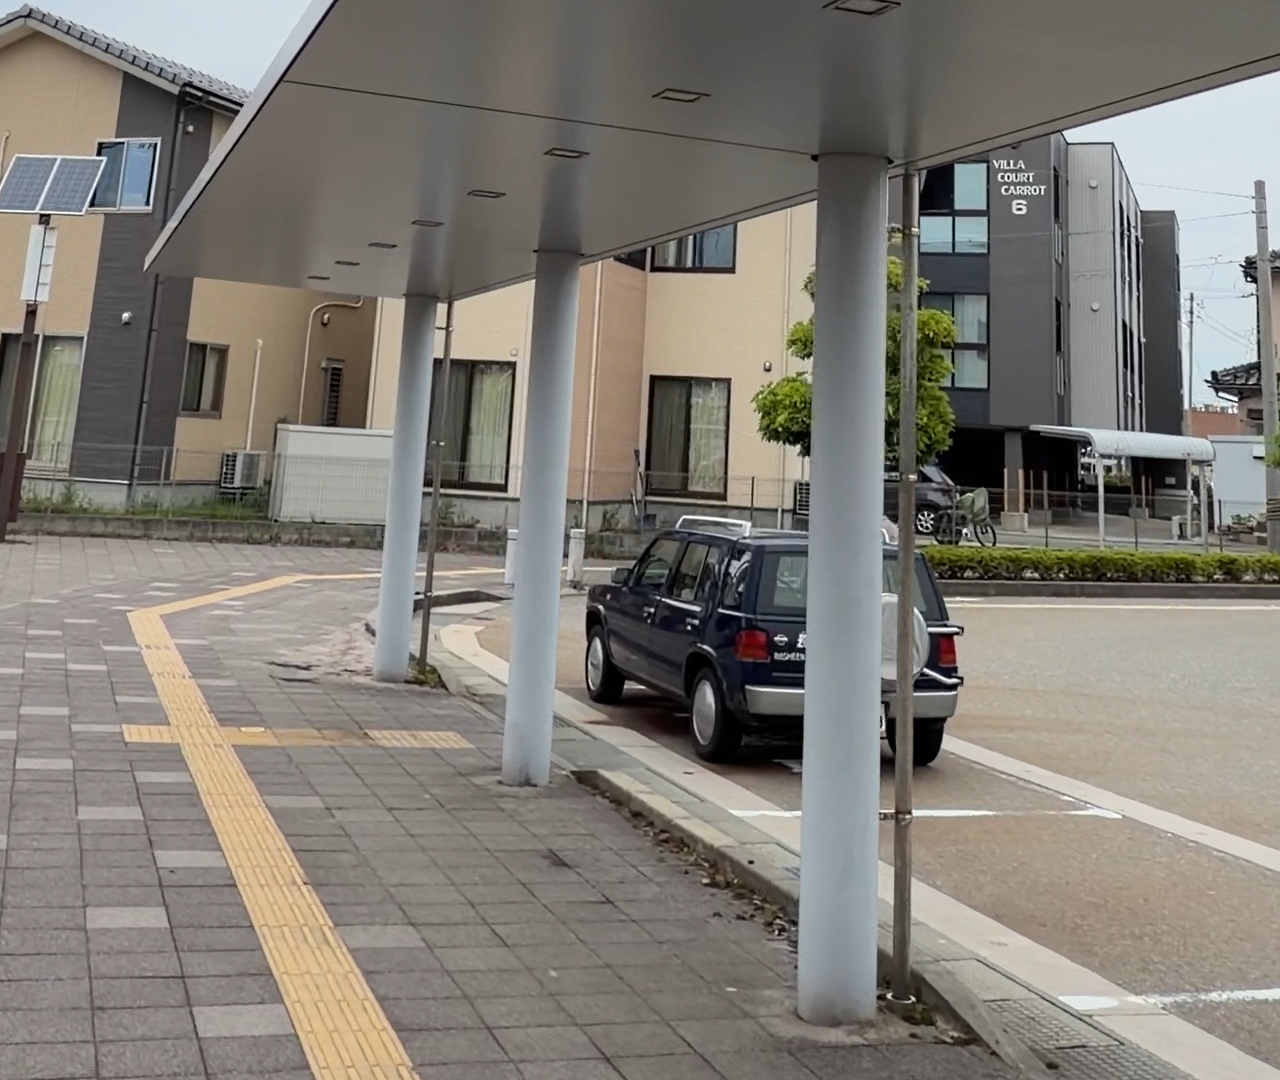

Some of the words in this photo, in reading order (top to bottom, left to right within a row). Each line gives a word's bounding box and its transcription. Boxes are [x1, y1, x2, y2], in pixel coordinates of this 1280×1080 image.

[992, 159, 1026, 169] VILLA
[997, 172, 1035, 183] COURT
[1001, 185, 1047, 196] CARROT
[1011, 199, 1028, 215] 6
